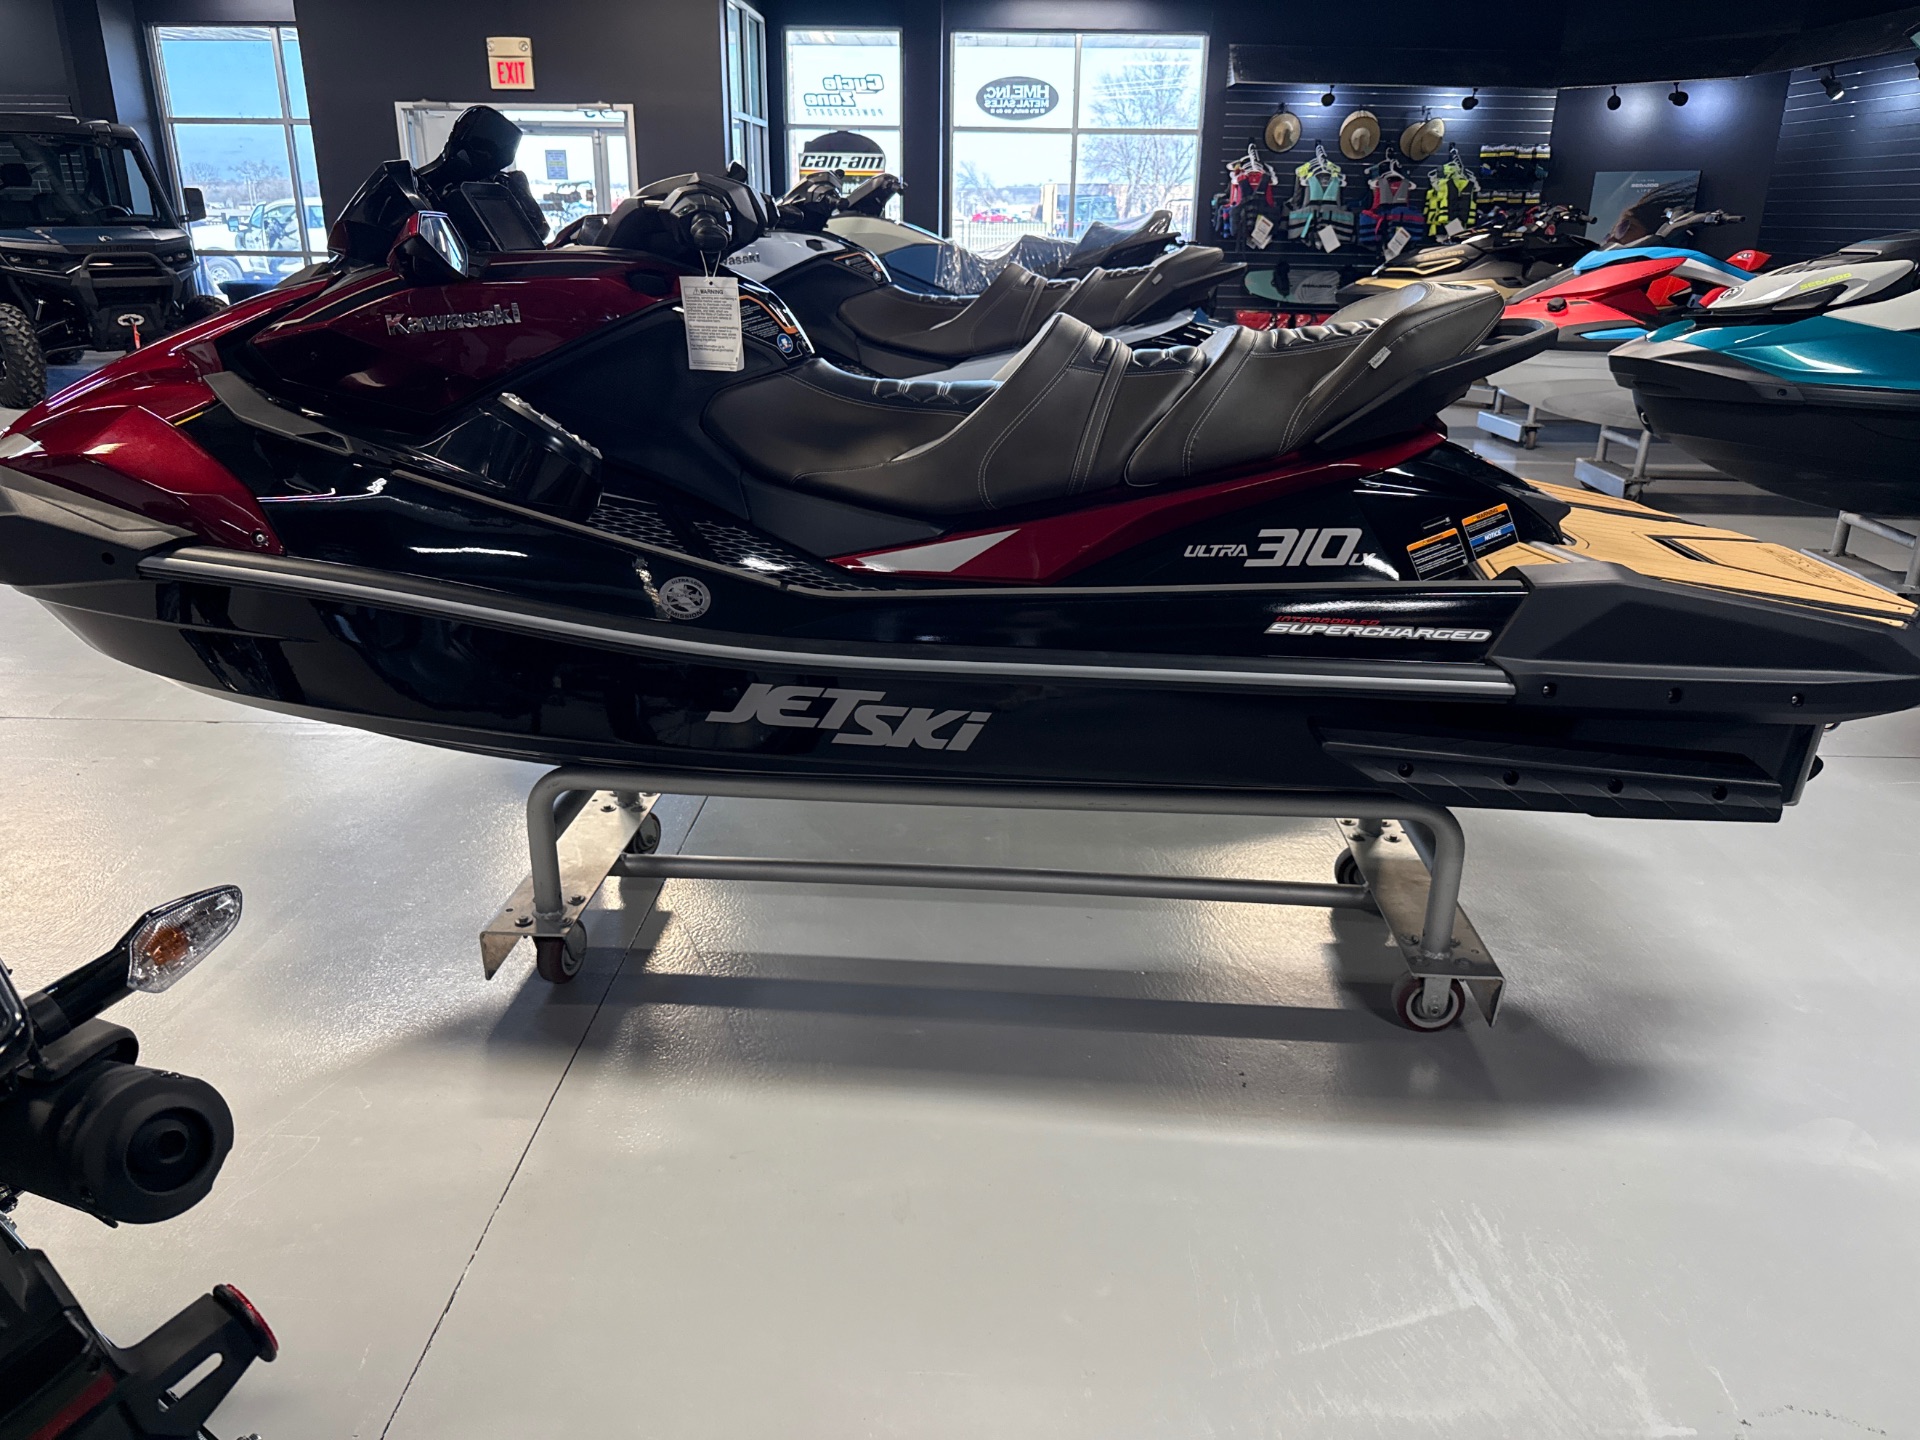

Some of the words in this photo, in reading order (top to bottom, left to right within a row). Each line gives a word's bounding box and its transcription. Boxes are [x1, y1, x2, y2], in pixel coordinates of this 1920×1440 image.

[497, 61, 525, 84] EXIT
[801, 155, 884, 169] can-am
[385, 302, 521, 335] Kawasaki
[1476, 507, 1499, 520] WARNING
[1484, 529, 1502, 541] NOTICE
[1183, 544, 1249, 558] ULTRA
[1266, 621, 1489, 642] SUPERCHARGED
[705, 682, 886, 730] JET
